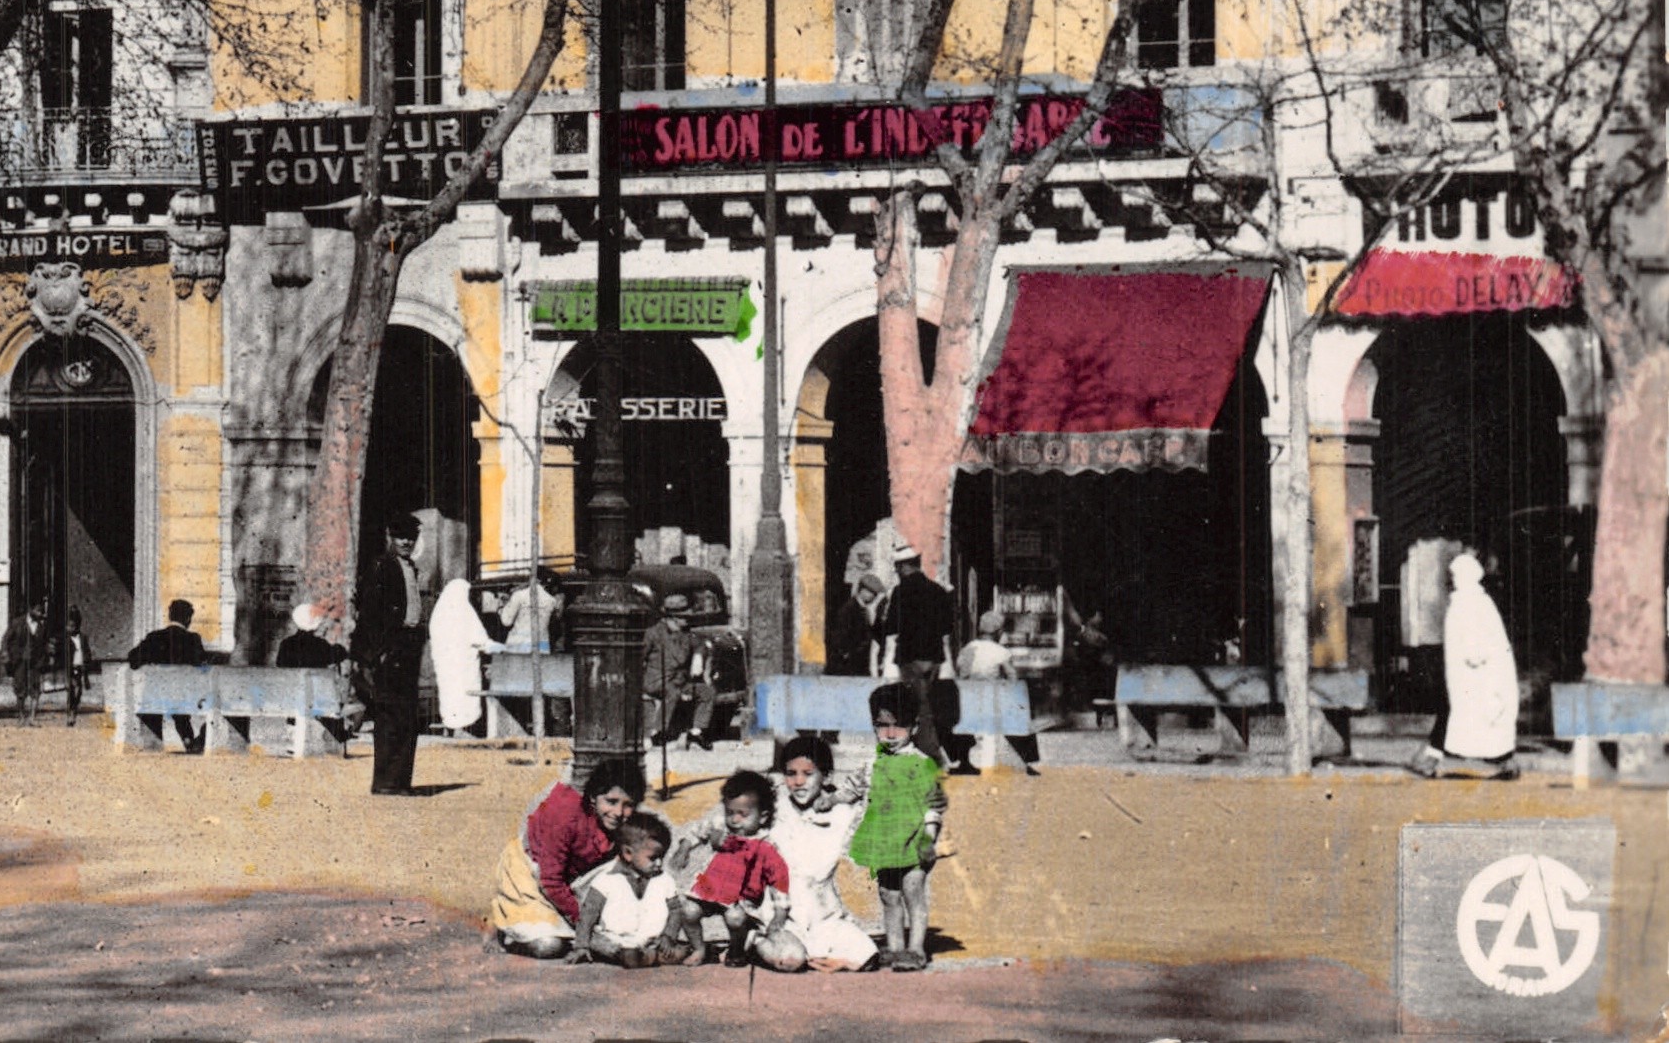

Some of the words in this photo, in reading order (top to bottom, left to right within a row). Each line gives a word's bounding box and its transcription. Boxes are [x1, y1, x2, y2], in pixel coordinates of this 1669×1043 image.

[655, 113, 760, 164] SALON
[782, 123, 823, 159] DE
[56, 235, 138, 256] HOTEL
[1018, 438, 1090, 466] BON
